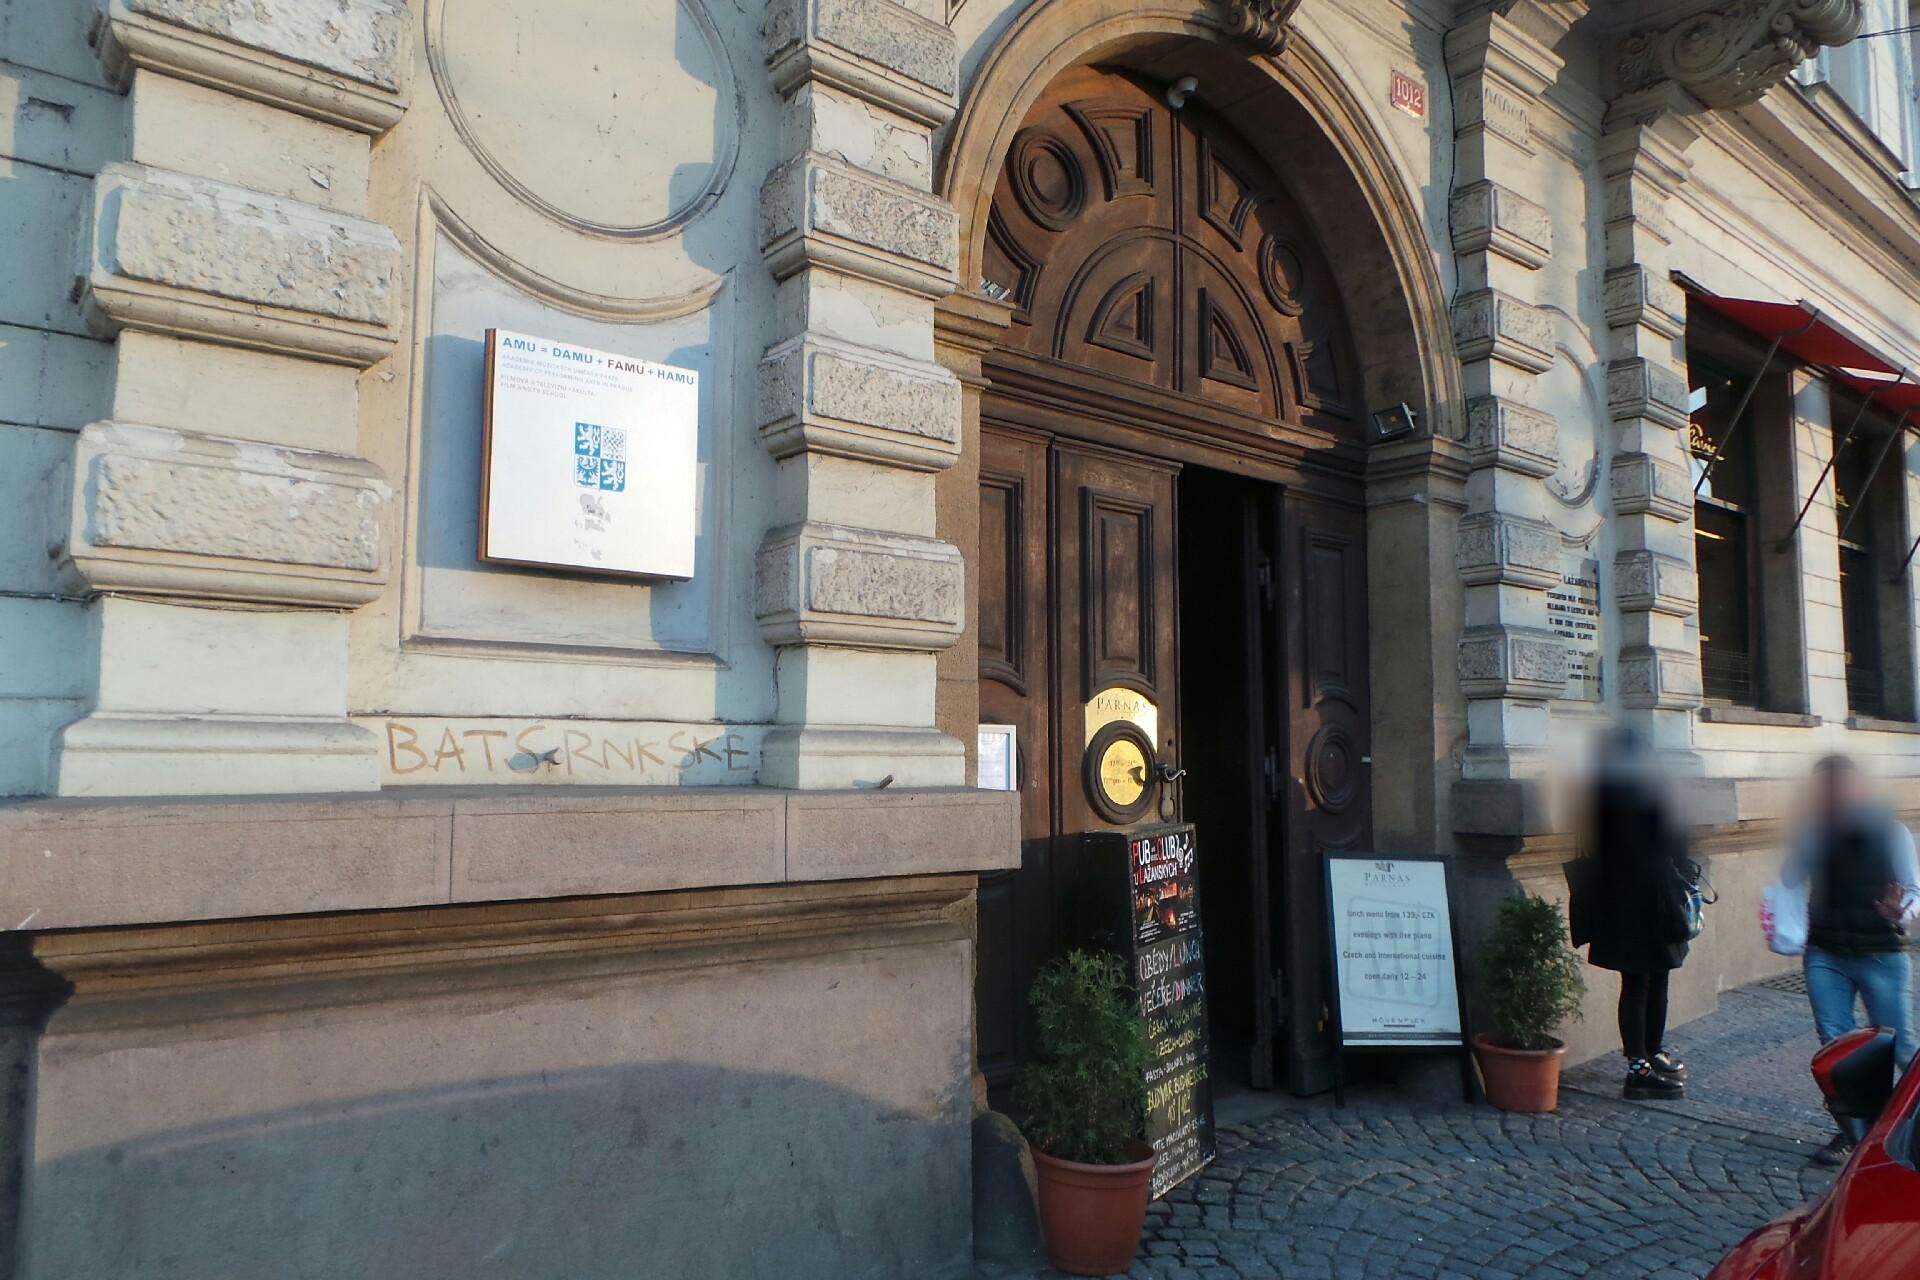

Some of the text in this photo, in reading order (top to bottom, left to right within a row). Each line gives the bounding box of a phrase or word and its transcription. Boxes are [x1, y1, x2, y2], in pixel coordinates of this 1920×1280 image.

[1396, 77, 1422, 108] 1012
[503, 337, 536, 353] AMU
[552, 347, 593, 364] DAMU
[607, 359, 645, 375] FAMU
[657, 370, 694, 385] HAMU
[1132, 839, 1151, 866] PUB
[1157, 834, 1177, 861] CLUB
[1364, 872, 1411, 883] PARNAS
[1343, 951, 1363, 959] Czech
[1364, 951, 1376, 959] and
[1421, 952, 1446, 960] cuisine
[1364, 973, 1380, 982] open
[1400, 972, 1409, 981] 12
